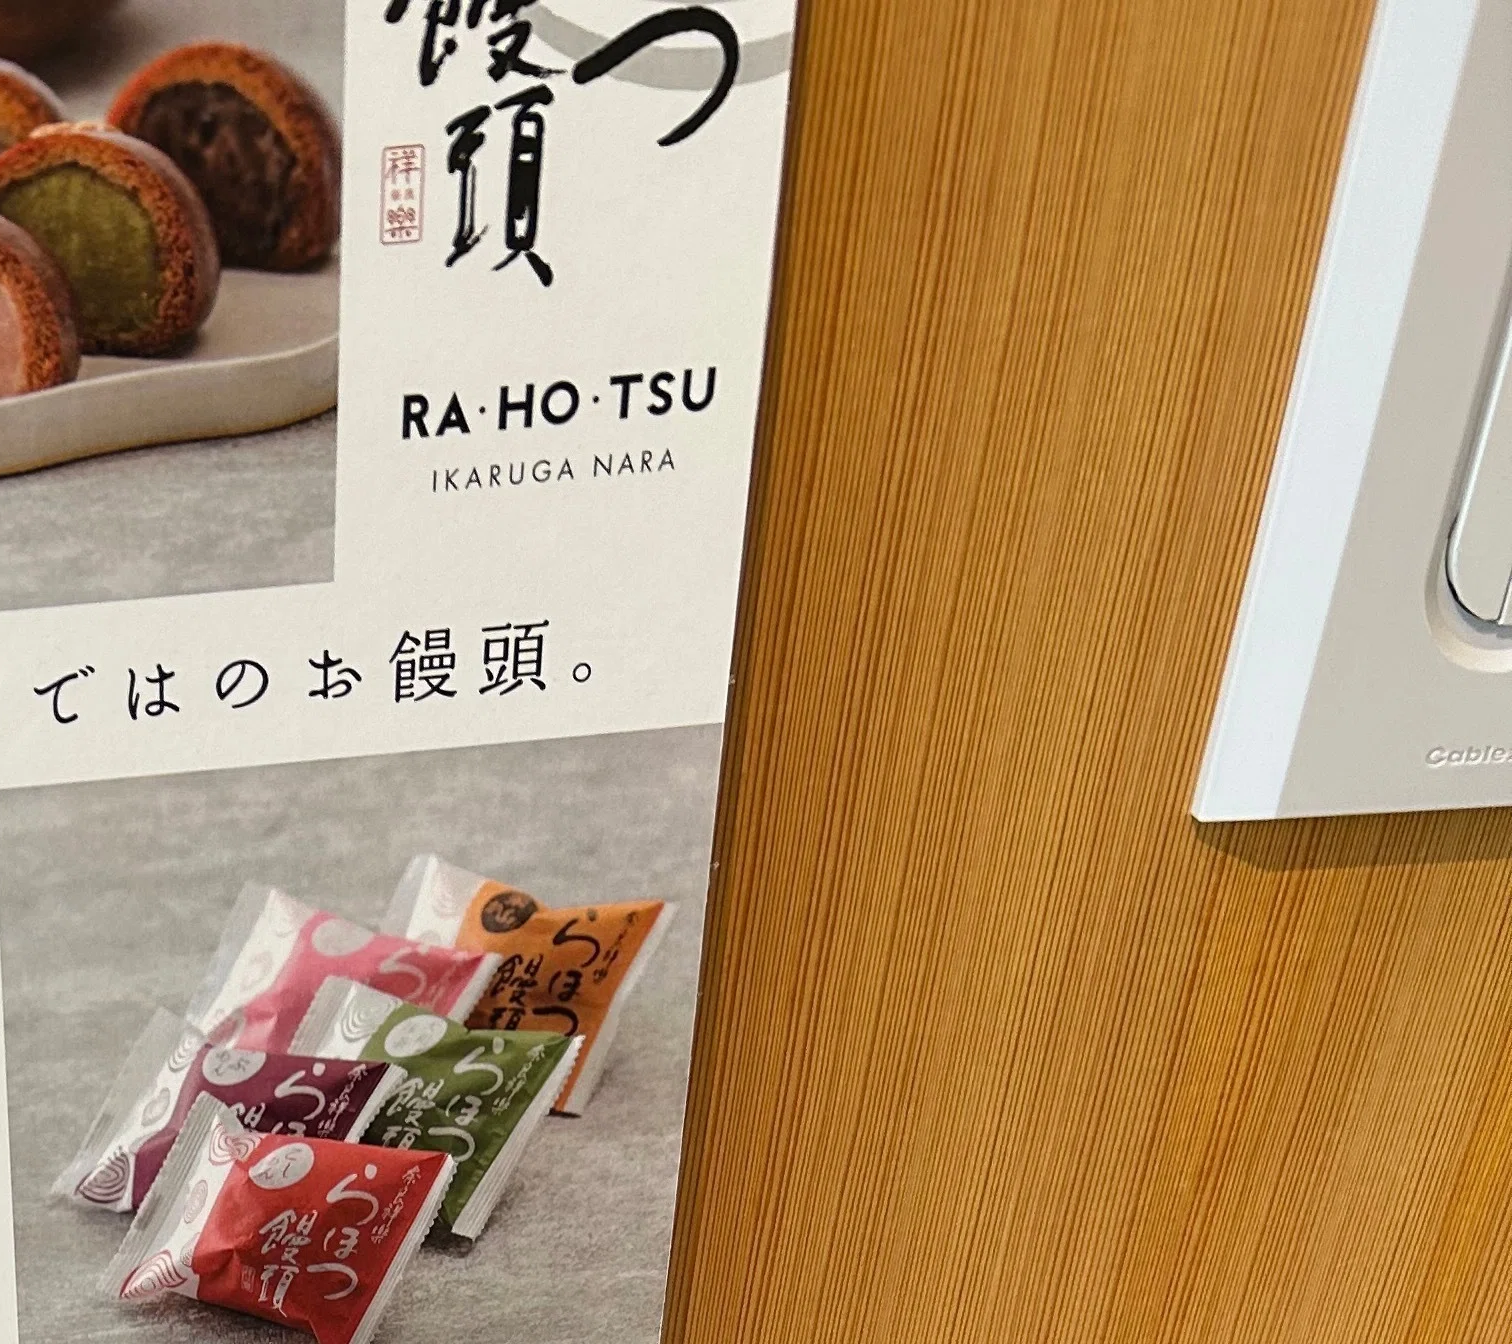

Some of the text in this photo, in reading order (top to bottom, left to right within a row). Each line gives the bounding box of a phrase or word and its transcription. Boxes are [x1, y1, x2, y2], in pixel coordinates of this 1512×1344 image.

[432, 448, 676, 493] IKARUGA NARA
[258, 1208, 319, 1319] 饅頭
[306, 1162, 380, 1301] らほつ
